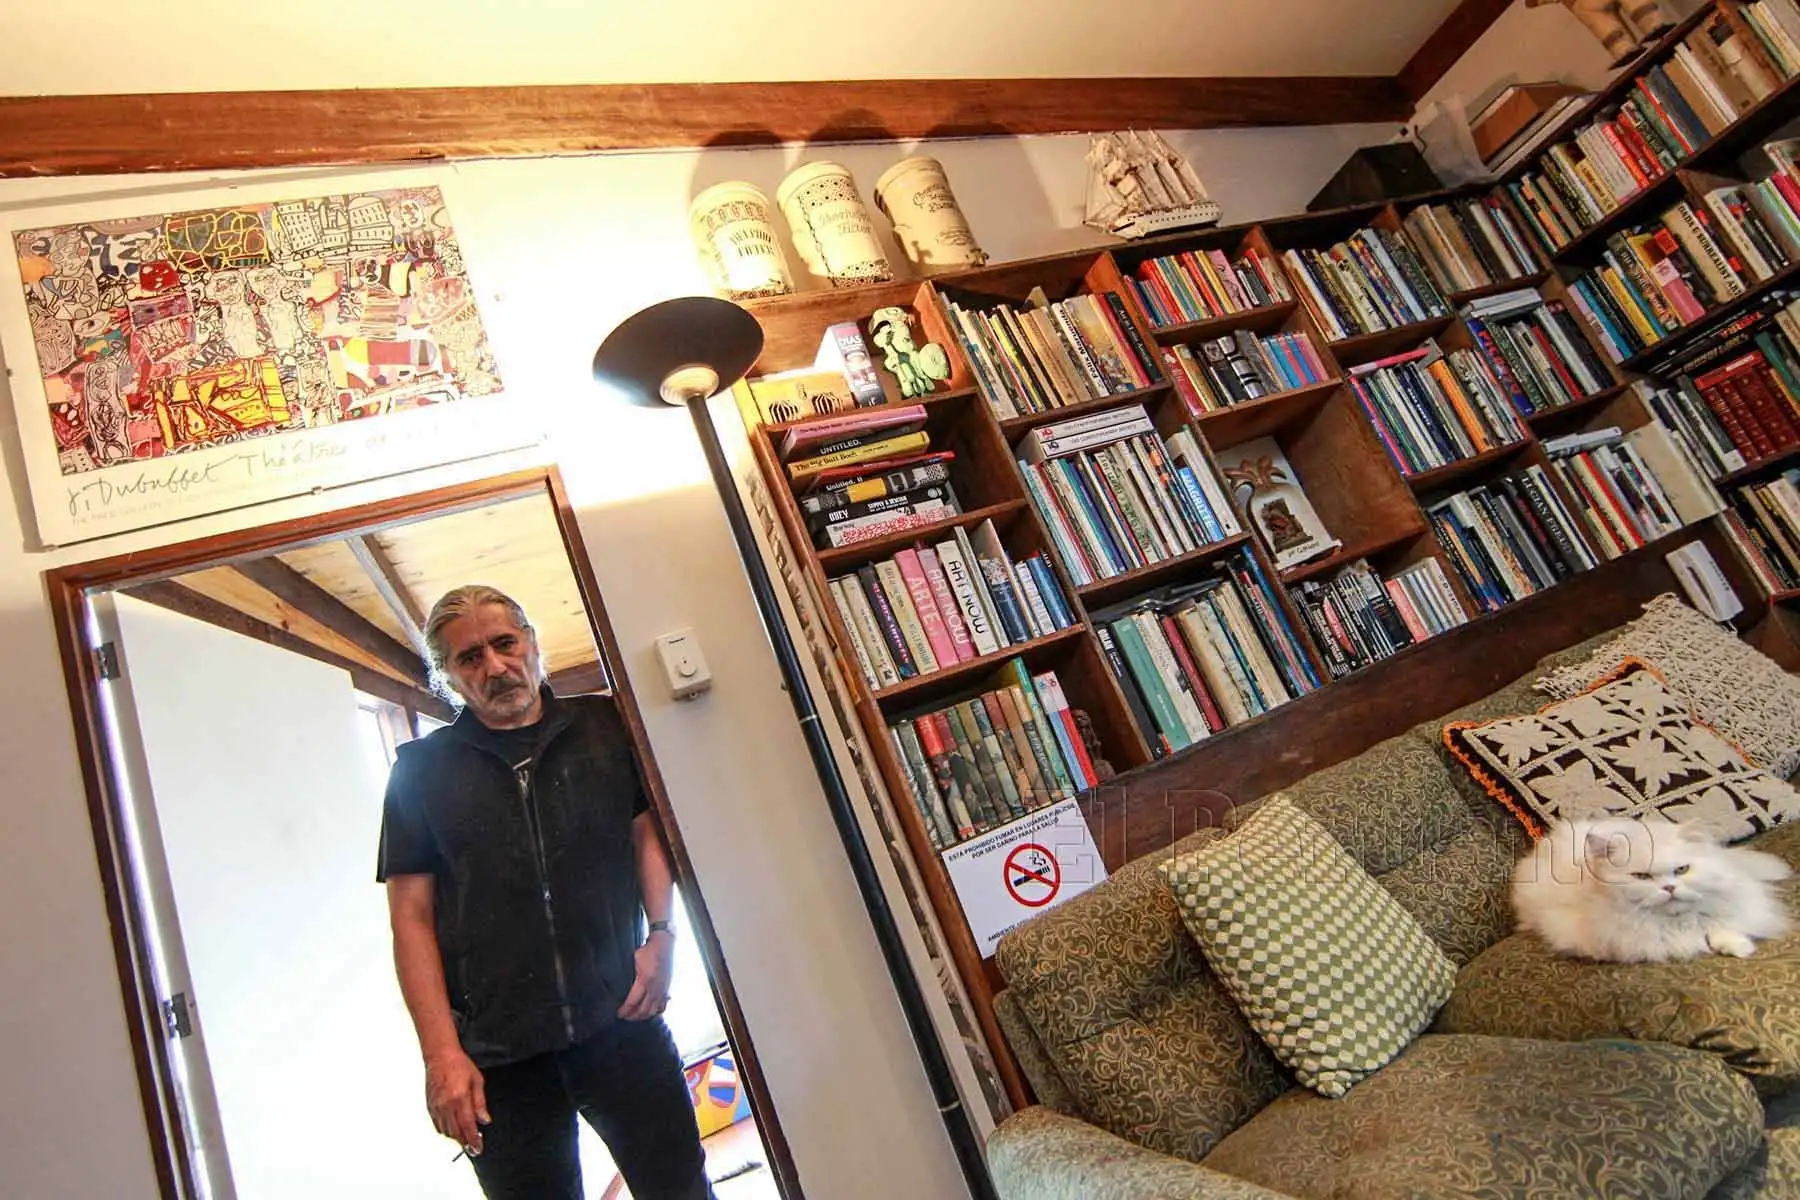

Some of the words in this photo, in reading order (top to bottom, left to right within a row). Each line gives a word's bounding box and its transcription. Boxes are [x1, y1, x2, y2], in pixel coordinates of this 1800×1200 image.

[1676, 204, 1695, 227] DADA
[1695, 232, 1730, 280] SURREALIST
[795, 461, 810, 471] The
[820, 439, 862, 455] UNTITLED.
[829, 509, 848, 522] OBEY
[1518, 475, 1550, 516] LUCIAN
[1544, 515, 1574, 554] FREUD
[924, 566, 951, 601] ART
[940, 600, 972, 646] NOW
[946, 558, 970, 589] ART
[961, 591, 991, 634] NOW
[964, 837, 995, 854] PROHIBIDO
[996, 828, 1014, 842] FUMAR
[1014, 824, 1023, 832] EN
[1024, 813, 1049, 829] LUGARES
[972, 849, 984, 859] POR
[985, 843, 997, 853] SER
[1018, 827, 1033, 839] PARA
